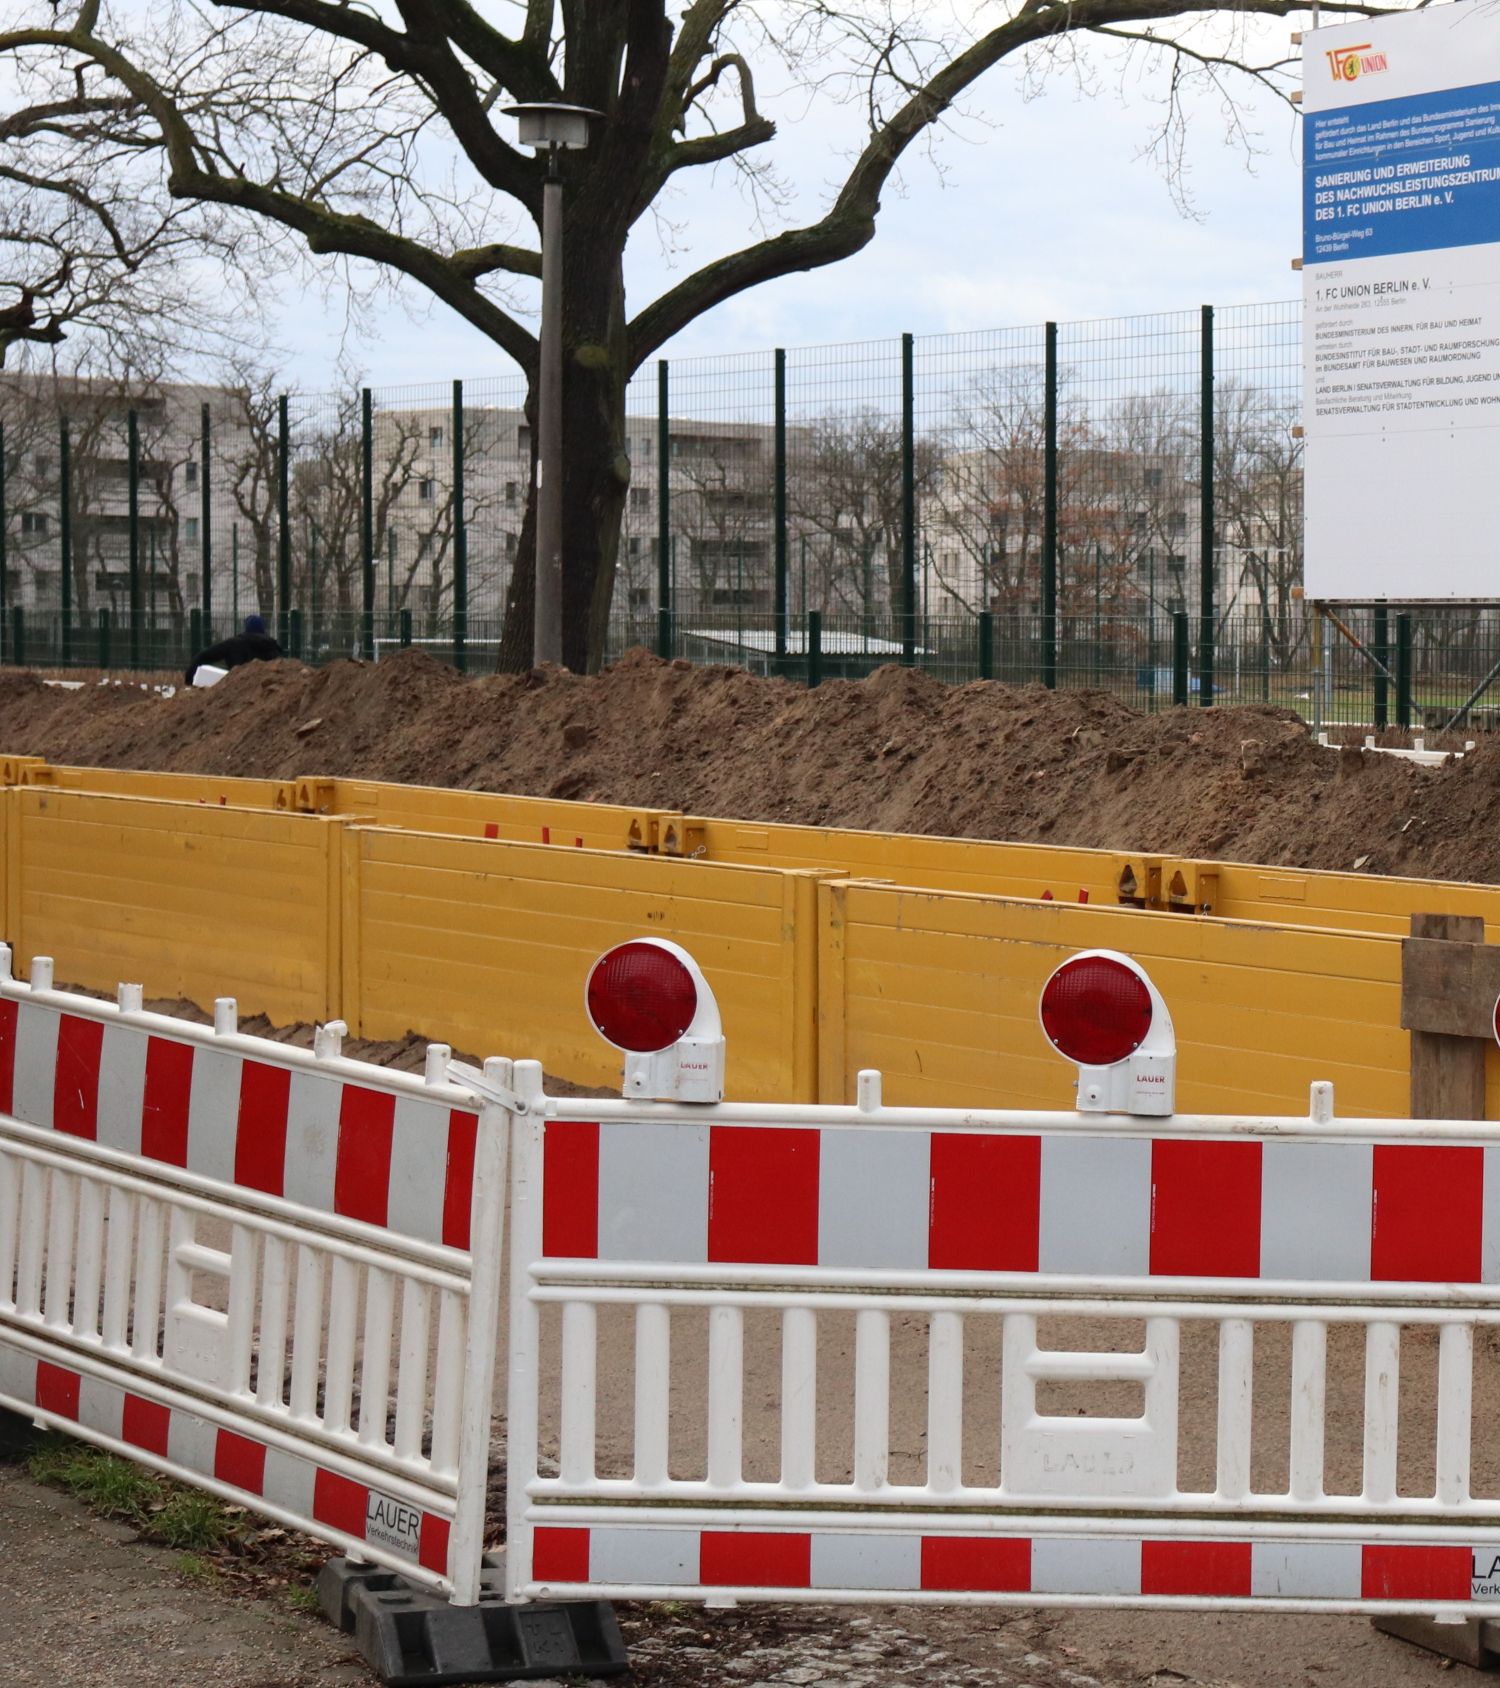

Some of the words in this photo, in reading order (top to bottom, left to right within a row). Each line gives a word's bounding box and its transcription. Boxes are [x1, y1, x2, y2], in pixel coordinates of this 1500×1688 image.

[1361, 54, 1387, 74] UNION
[1383, 119, 1399, 130] Berlin
[1399, 117, 1410, 126] und
[1453, 131, 1475, 142] Jugend
[1475, 129, 1487, 138] und
[1315, 168, 1371, 188] SANIERUNG
[1374, 165, 1395, 181] UND
[1397, 154, 1471, 178] ERWEITERUNG
[1316, 190, 1335, 205] DES
[1316, 206, 1335, 221] DES
[1337, 205, 1346, 218] 1.
[1347, 203, 1361, 217] FC
[1363, 198, 1394, 215] UNION
[1395, 193, 1432, 211] BERLIN
[1434, 195, 1443, 206] e.
[1444, 190, 1455, 204] V.
[1333, 242, 1350, 252] Berlin
[1315, 270, 1343, 281] BAUHERR
[1326, 287, 1339, 300] FC
[1341, 283, 1371, 298] UNION
[1374, 279, 1410, 295] BERLIN
[1411, 281, 1420, 291] e.
[1422, 277, 1431, 290] V.
[1315, 326, 1377, 341] BUNDESMINISTERIUM
[1377, 325, 1390, 335] DES
[1415, 320, 1428, 332] FÜR
[1430, 319, 1443, 330] BAU
[1444, 318, 1458, 328] UND
[1459, 316, 1482, 326] HEIMAT
[1315, 349, 1367, 362] BUNDESINSTITUT
[1368, 346, 1381, 357] FÜR
[1400, 343, 1423, 355] STADT-
[1424, 342, 1438, 353] UND
[1439, 338, 1500, 351] RAUMFORSCHUNG
[1324, 359, 1361, 373] BUNDESAMT
[1362, 357, 1375, 369] FÜR
[1377, 354, 1413, 367] BAUWESEN
[1414, 353, 1427, 365] UND
[1429, 351, 1481, 364] RAUMORDNUNG
[1315, 384, 1332, 395] LAND
[1332, 382, 1353, 394] BERLIN
[1357, 378, 1422, 392] SENATSVERWALTUNG
[1422, 376, 1436, 387] FÜR
[1436, 374, 1466, 386] BILDUNG,
[1466, 372, 1492, 383] JUGEND
[1316, 402, 1381, 416] SENATSVERWALTUNG
[1382, 399, 1395, 412] FÜR
[1396, 397, 1463, 410] STADTENTWICKLUNG
[1464, 396, 1479, 406] UND
[680, 1061, 708, 1070] LAUER
[1137, 1074, 1165, 1084] LAUER
[366, 1494, 420, 1540] LAUER
[367, 1523, 419, 1554] Verkehrstechnik
